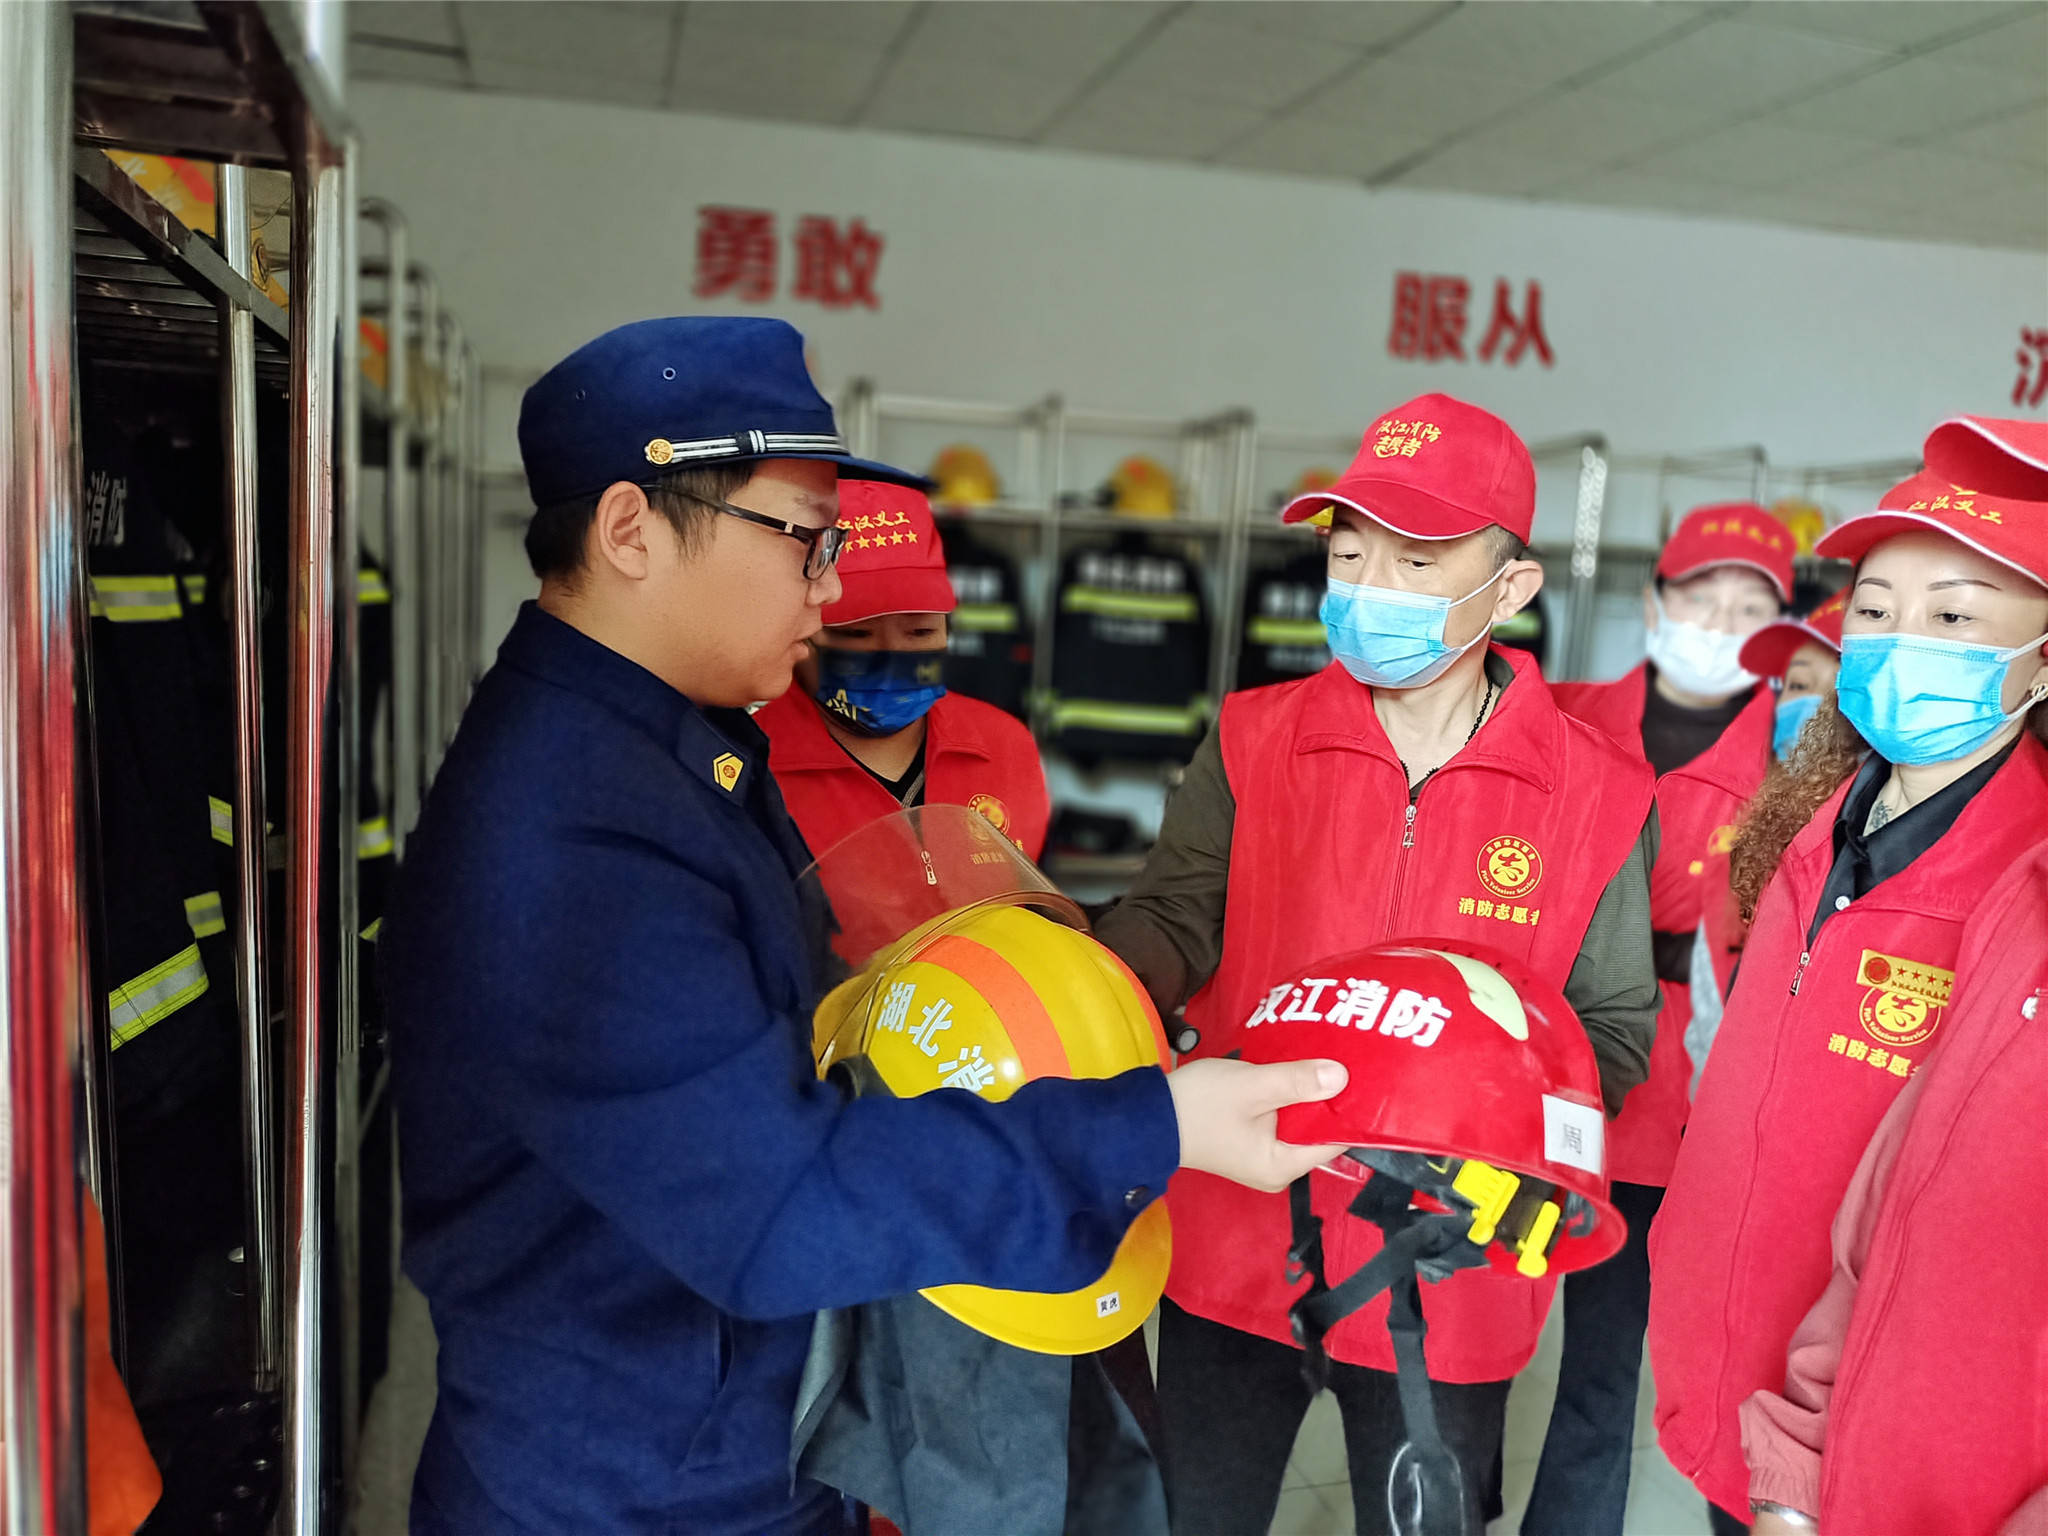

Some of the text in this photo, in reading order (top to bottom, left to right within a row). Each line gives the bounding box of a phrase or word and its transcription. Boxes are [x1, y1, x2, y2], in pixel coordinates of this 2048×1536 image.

[693, 204, 884, 311] 勇敢
[1388, 270, 1556, 368] 服从
[1245, 977, 1453, 1048] 汉江消防
